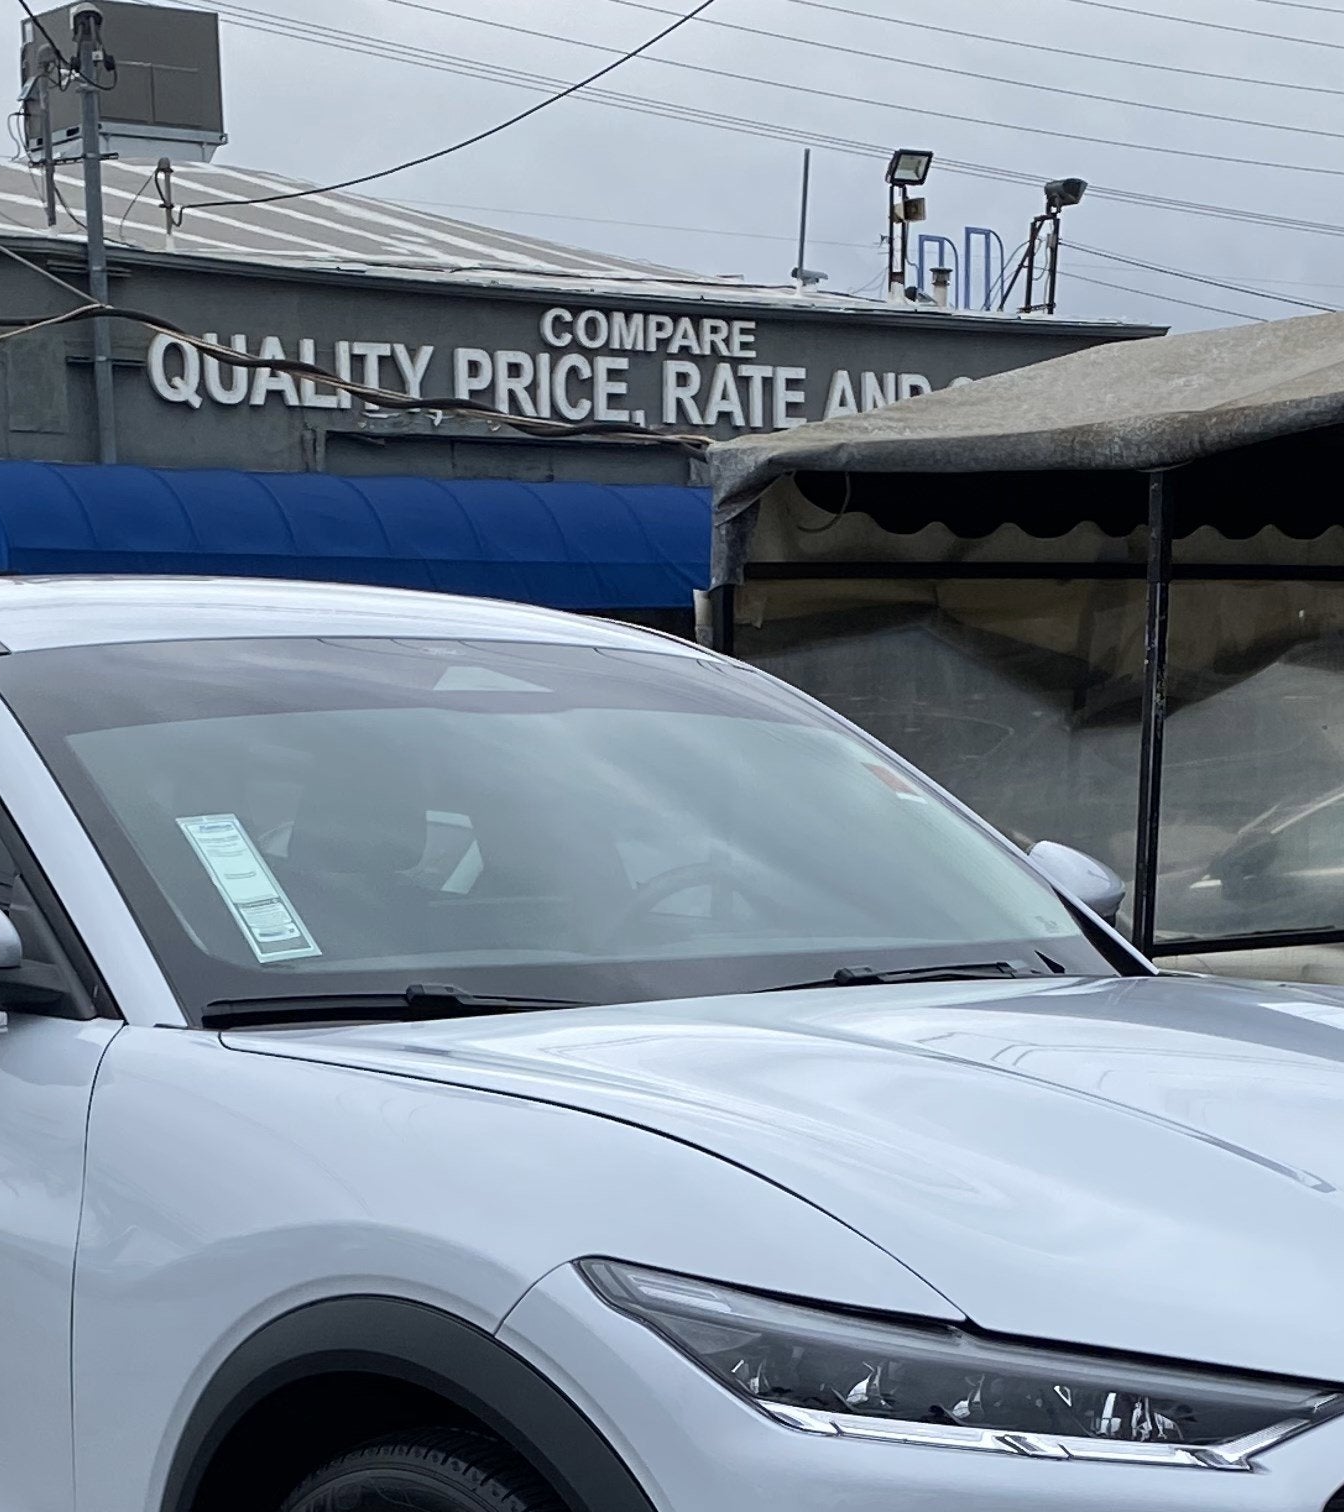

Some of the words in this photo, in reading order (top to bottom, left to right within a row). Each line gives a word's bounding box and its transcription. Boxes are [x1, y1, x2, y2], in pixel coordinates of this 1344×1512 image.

[540, 308, 758, 358] COMPARE
[147, 332, 435, 410] QUALITY
[453, 347, 646, 428] PRICE,
[662, 358, 808, 429] RATE
[823, 369, 932, 421] AND
